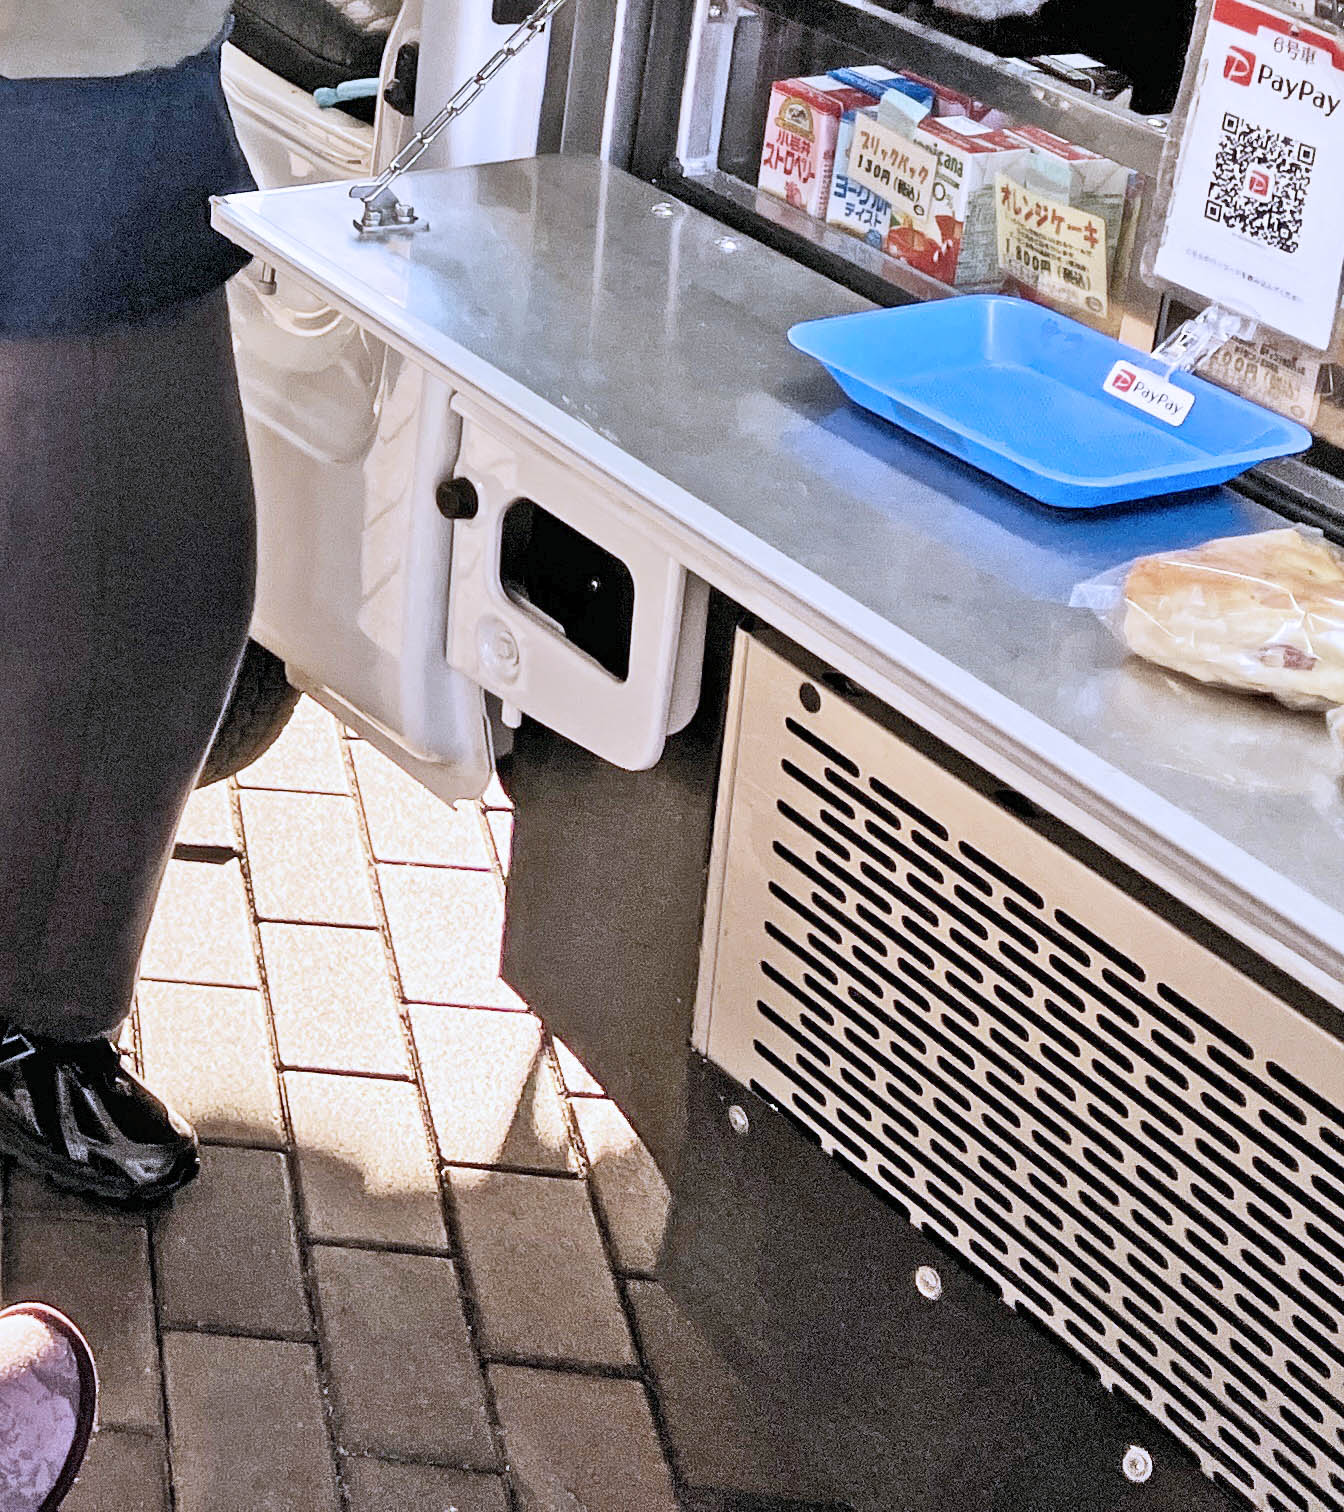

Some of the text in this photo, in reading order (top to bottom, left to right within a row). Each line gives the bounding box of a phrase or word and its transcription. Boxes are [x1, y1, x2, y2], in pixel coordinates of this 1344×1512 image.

[1274, 37, 1316, 65] 6号車
[1257, 64, 1341, 117] PayPay
[1133, 381, 1184, 416] PayPay
